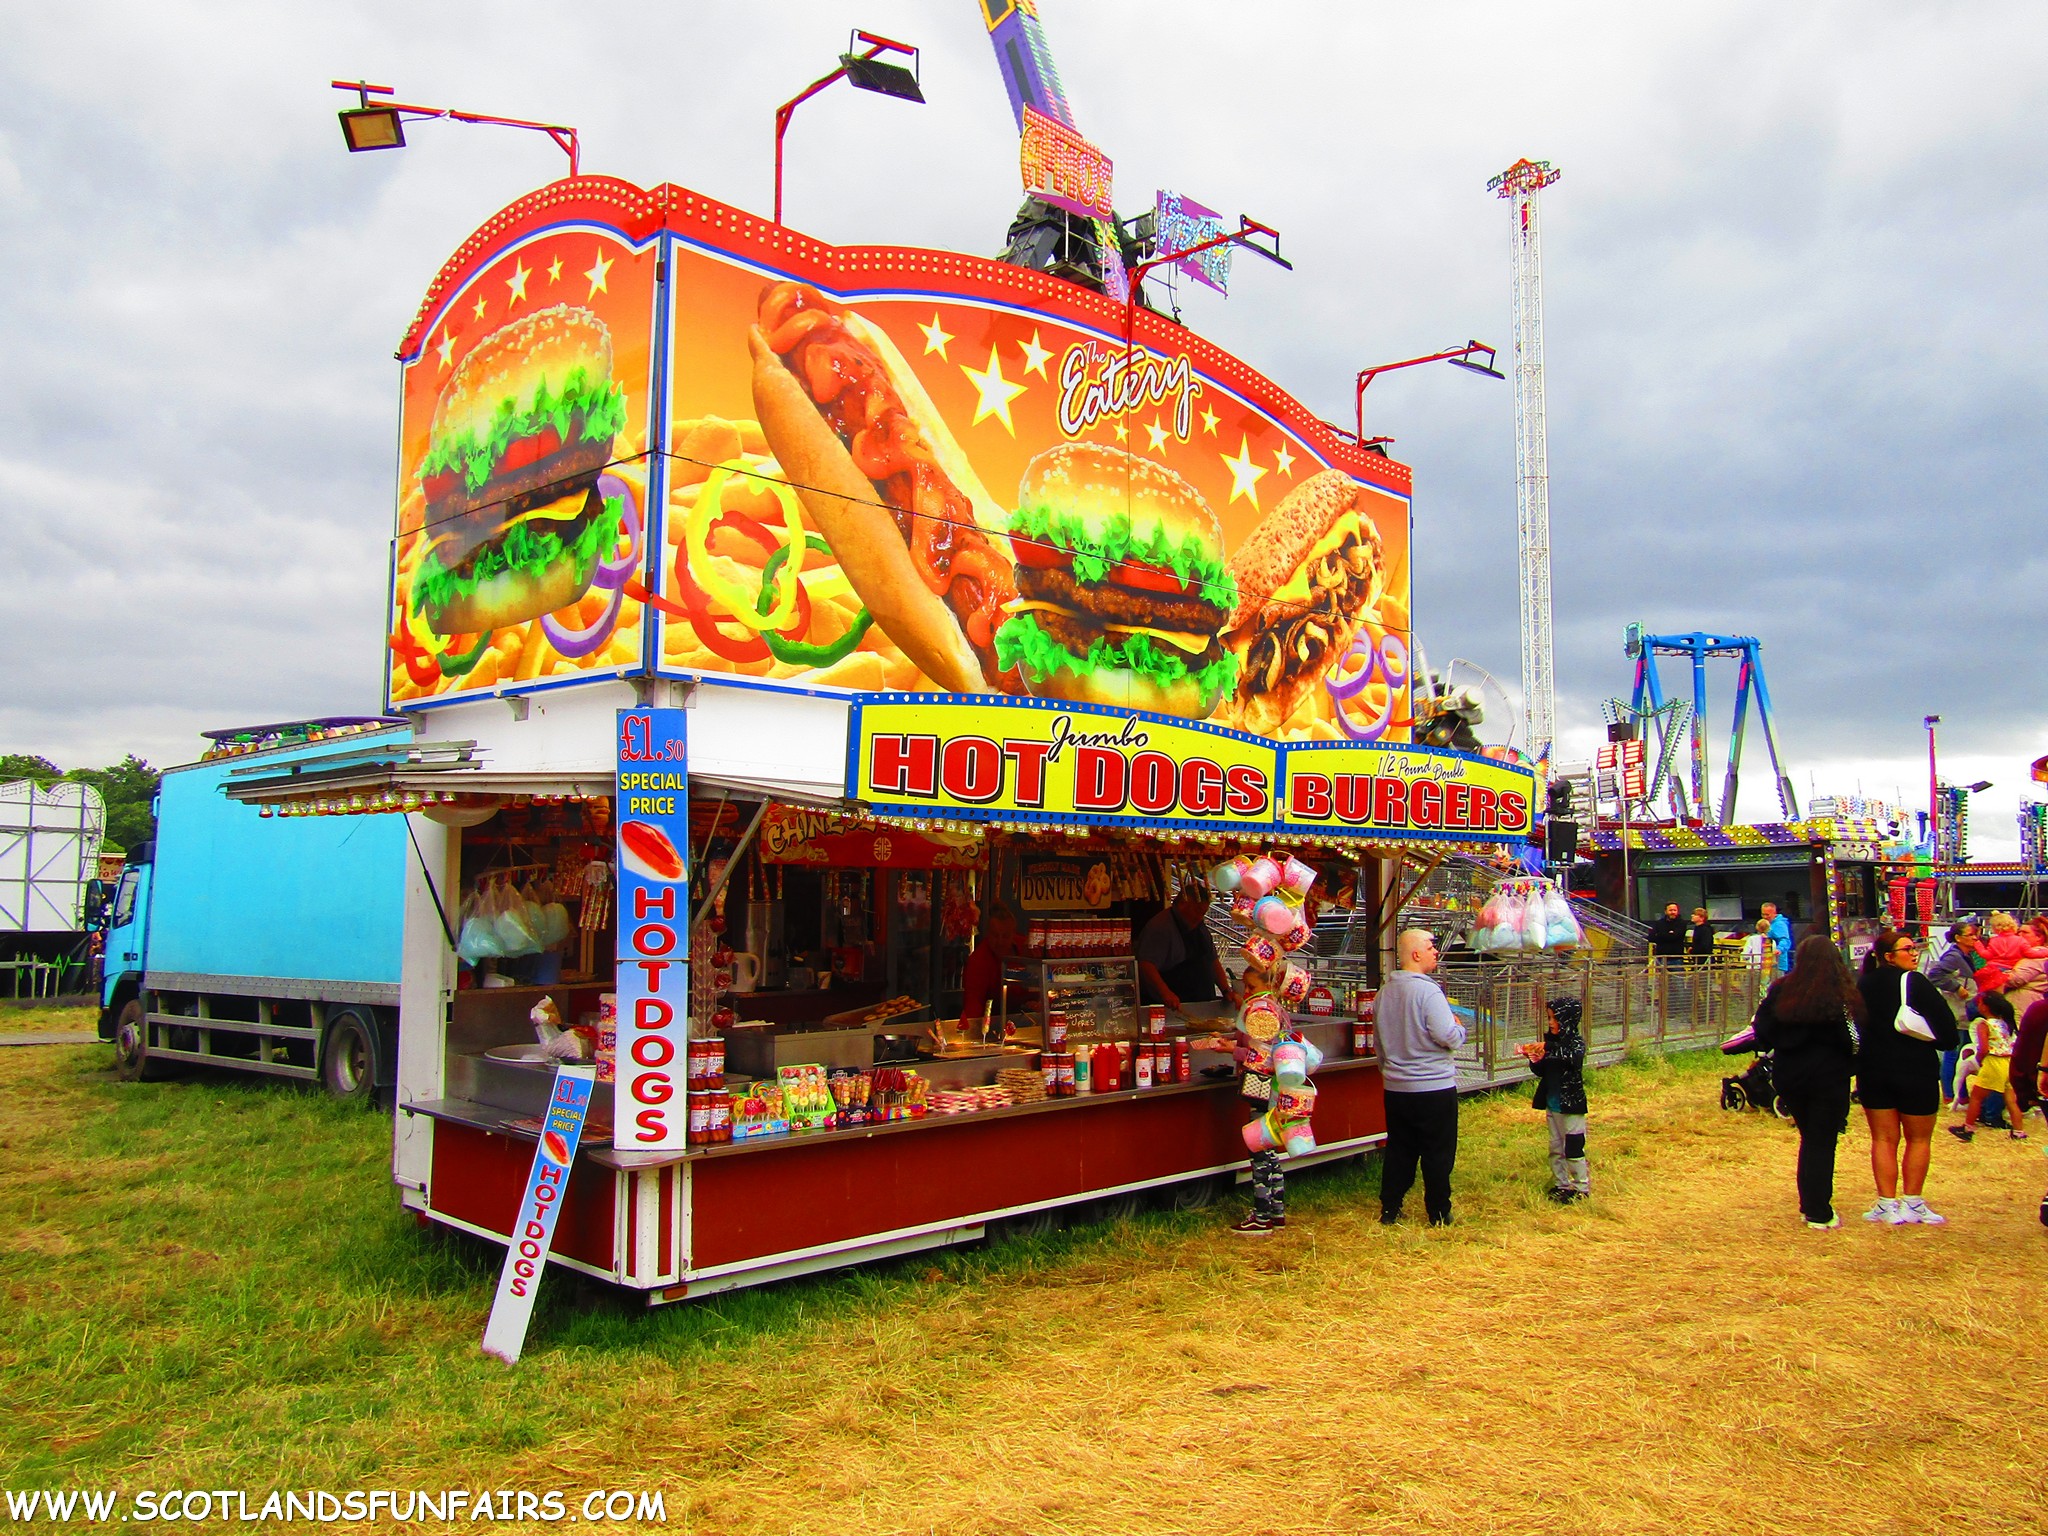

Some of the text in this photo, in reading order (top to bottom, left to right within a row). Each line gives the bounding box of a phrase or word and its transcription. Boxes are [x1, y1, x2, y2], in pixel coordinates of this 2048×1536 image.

[1082, 340, 1107, 364] The
[1057, 346, 1202, 441] Eatery
[620, 715, 685, 761] £1.50
[1047, 715, 1150, 763] Jumbo
[869, 732, 1269, 816] HOT DOGS
[1397, 753, 1432, 778] Pound
[1433, 757, 1465, 781] Double
[620, 772, 685, 790] SPECIAL
[630, 797, 675, 815] PRICE
[1291, 773, 1527, 831] BURGERS
[1023, 876, 1084, 901] DONUTS
[1310, 1005, 1331, 1013] ENTRY
[551, 1107, 583, 1121] SPECIAL
[552, 1119, 576, 1133] PRICE
